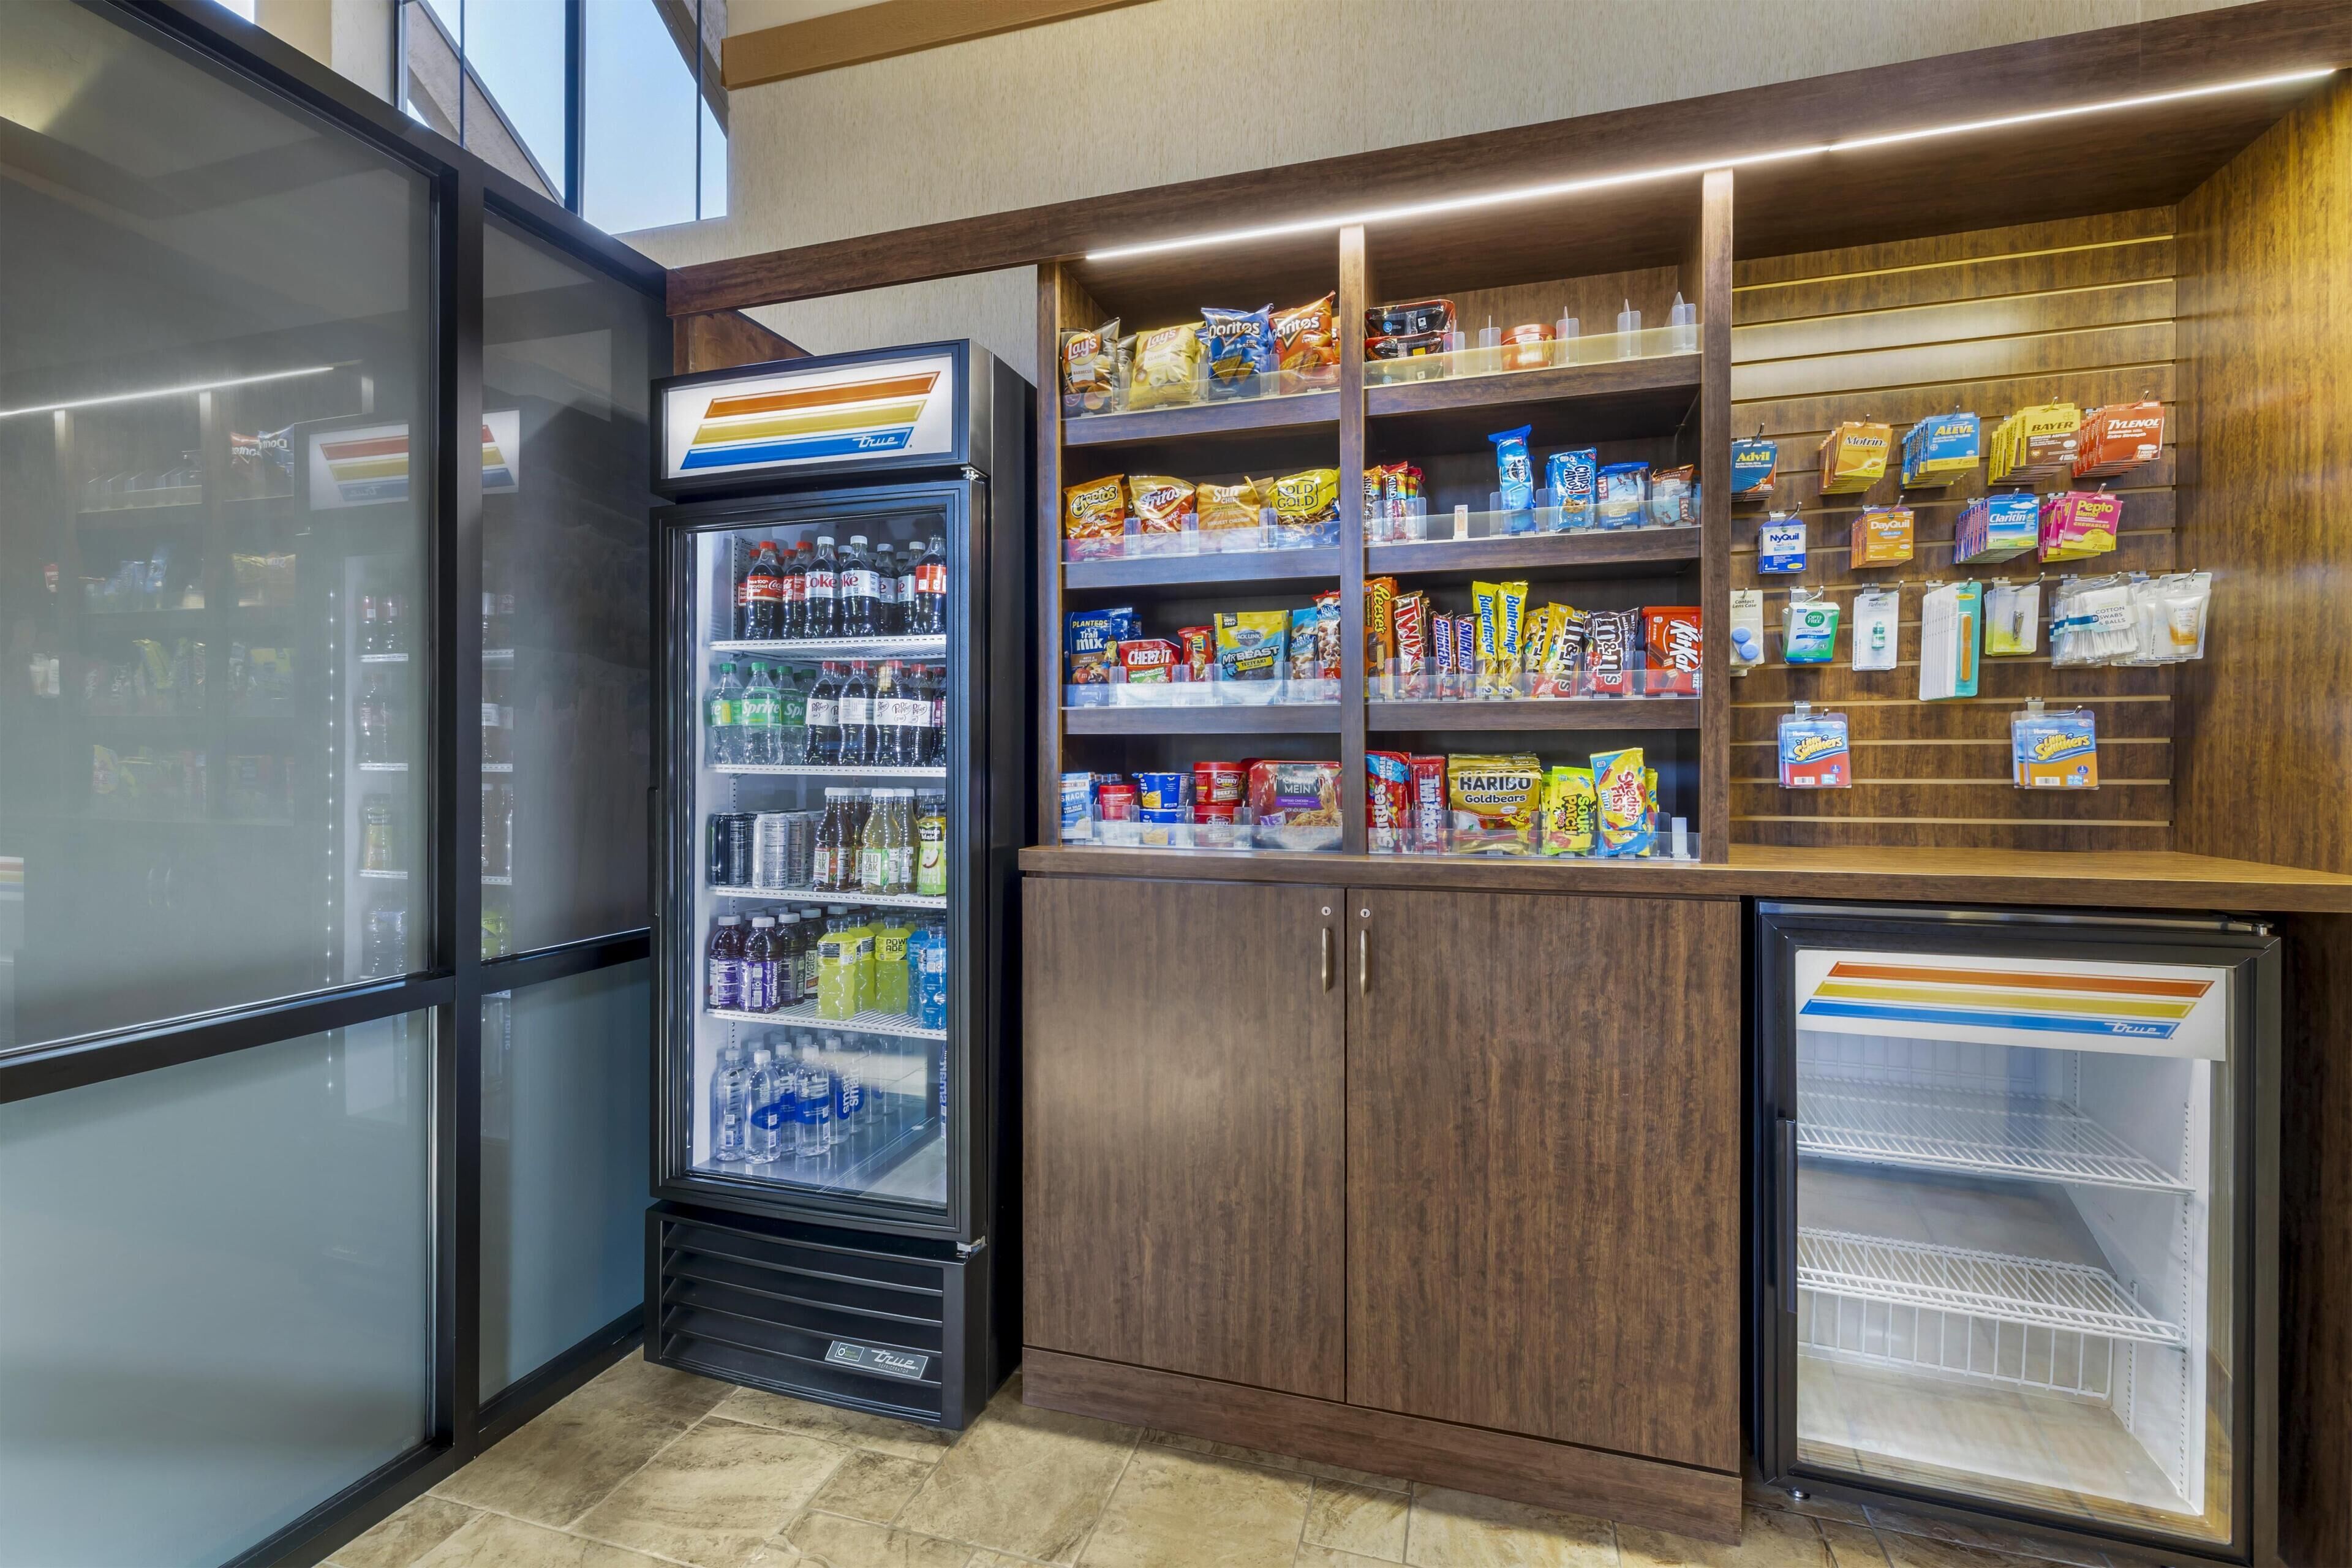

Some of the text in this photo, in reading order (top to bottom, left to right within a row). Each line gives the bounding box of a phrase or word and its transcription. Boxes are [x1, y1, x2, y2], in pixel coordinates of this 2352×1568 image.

[1208, 322, 1261, 337] Doritos
[1147, 329, 1177, 349] Lay's
[1068, 336, 1098, 360] Lay's
[1934, 425, 1974, 436] ALEVE
[2031, 421, 2075, 432] BAYER
[2107, 418, 2161, 430] TYLENOL
[852, 435, 900, 448] True
[1844, 435, 1883, 447] Motrin
[1736, 451, 1771, 462] Advil
[1363, 475, 1372, 494] KIND
[1574, 466, 1590, 489] Chips
[1277, 483, 1314, 497] ROLD
[1388, 475, 1396, 497] KIND
[1071, 485, 1117, 518] Cheetos
[1139, 489, 1182, 511] Fritos
[1277, 496, 1314, 508] GOLD
[2076, 500, 2114, 513] Pepto
[1870, 520, 1910, 531] DayQuil
[1989, 513, 2026, 523] Claritin
[1770, 532, 1800, 543] NyQuil
[805, 573, 837, 589] Coke
[1373, 583, 1391, 634] Reese's
[2095, 605, 2125, 615] COTTON
[1072, 619, 1108, 629] PLANTERS
[1478, 594, 1494, 655] Butterfinger
[1506, 595, 1520, 655] Butterfinger
[1079, 631, 1098, 639] Trail
[1191, 635, 1204, 652] RITZ
[1460, 622, 1473, 669] SNICKERS
[1595, 618, 1623, 685] m&m's
[742, 701, 780, 717] Sprite
[2034, 735, 2090, 761] Swimmers
[2043, 734, 2067, 747] Little
[1459, 770, 1531, 791] HARIBO
[1284, 785, 1311, 794] MEIN
[1464, 794, 1526, 804] Goldbears
[1563, 794, 1580, 836] PATCH
[1577, 796, 1591, 835] SOUR
[806, 951, 815, 979] water
[2104, 1022, 2161, 1035] True
[871, 1349, 916, 1370] True
[877, 1363, 910, 1374] REFRIGERATOR
